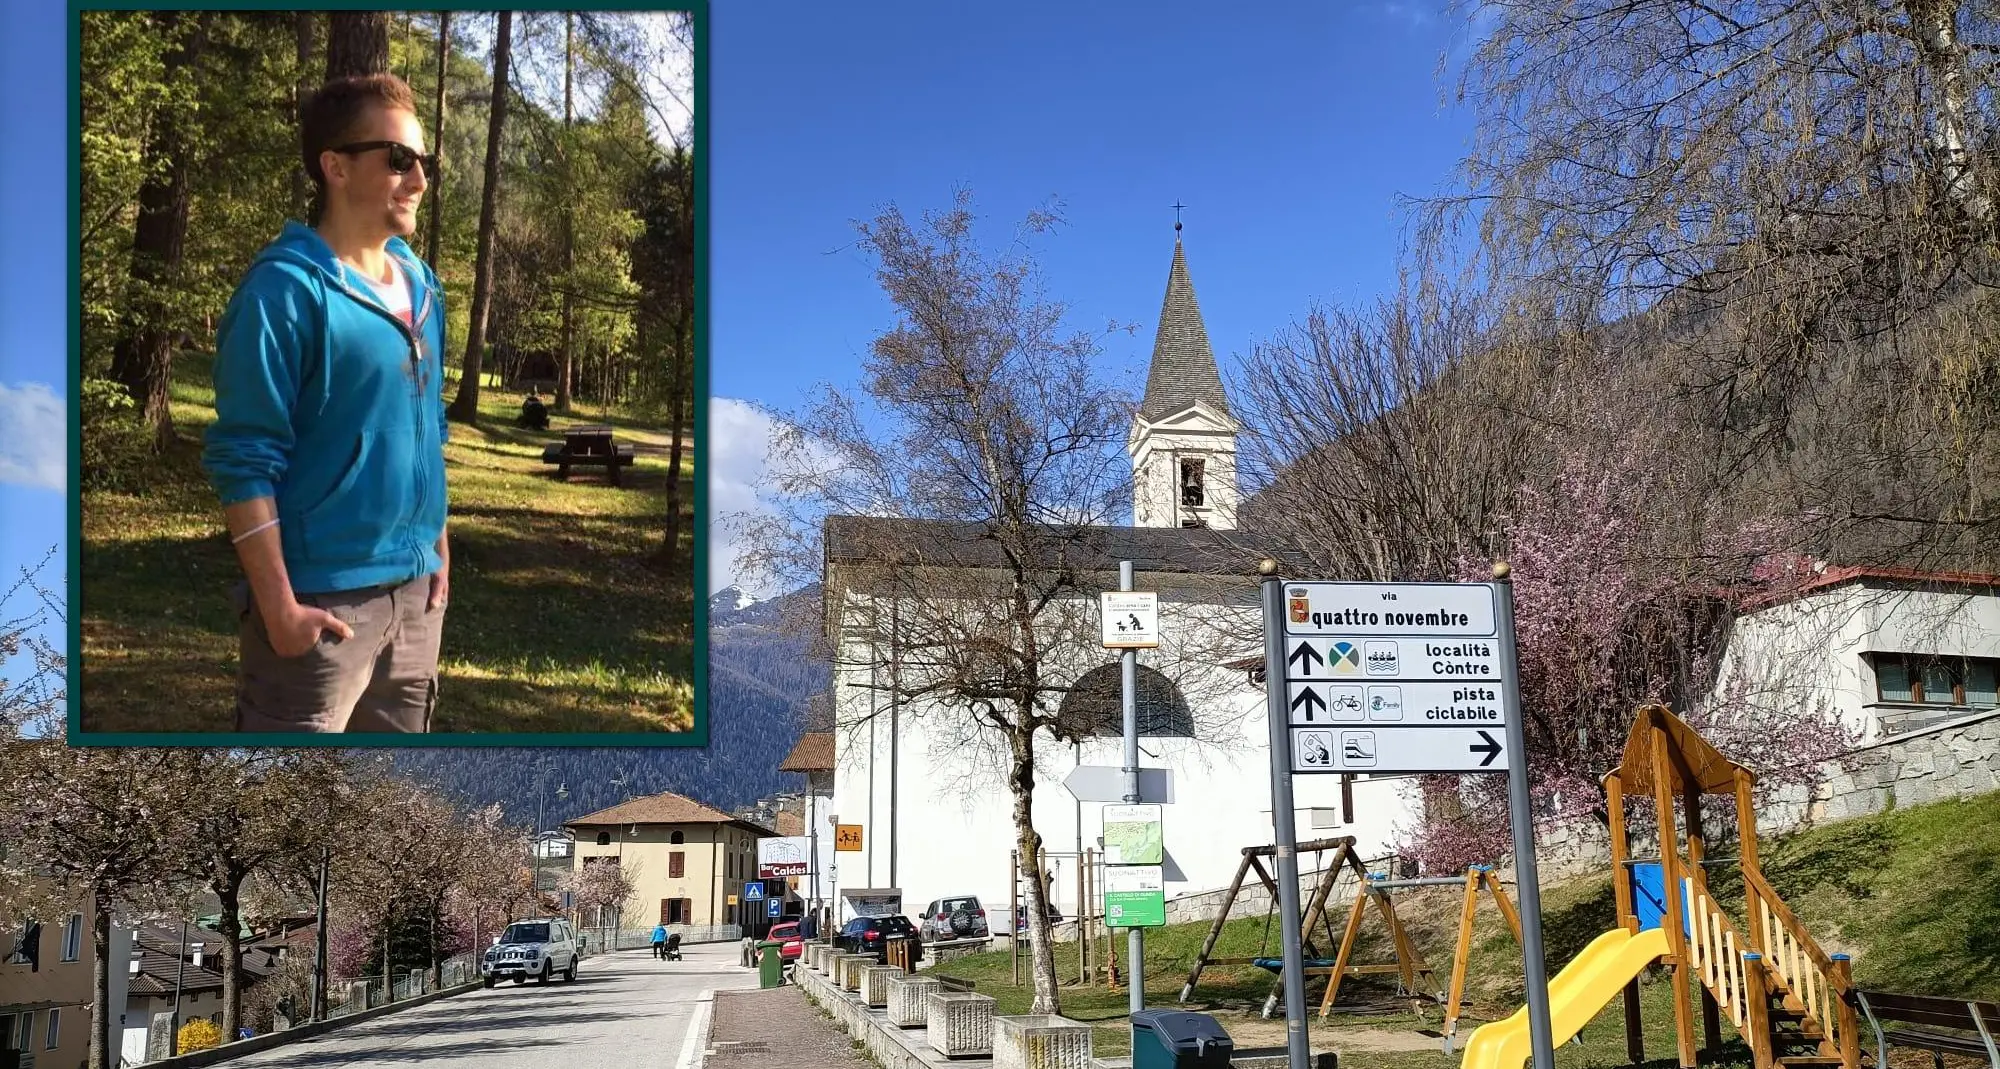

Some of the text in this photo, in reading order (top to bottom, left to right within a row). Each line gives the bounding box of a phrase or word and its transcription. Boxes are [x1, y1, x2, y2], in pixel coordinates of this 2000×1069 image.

[1381, 592, 1397, 601] via
[1312, 608, 1469, 629] quattro novembre
[1426, 643, 1490, 657] località
[1432, 661, 1490, 675] Còntre
[1453, 687, 1495, 703] pista
[1426, 706, 1497, 720] ciclabile
[772, 865, 806, 876] Caldes
[771, 901, 778, 909] P
